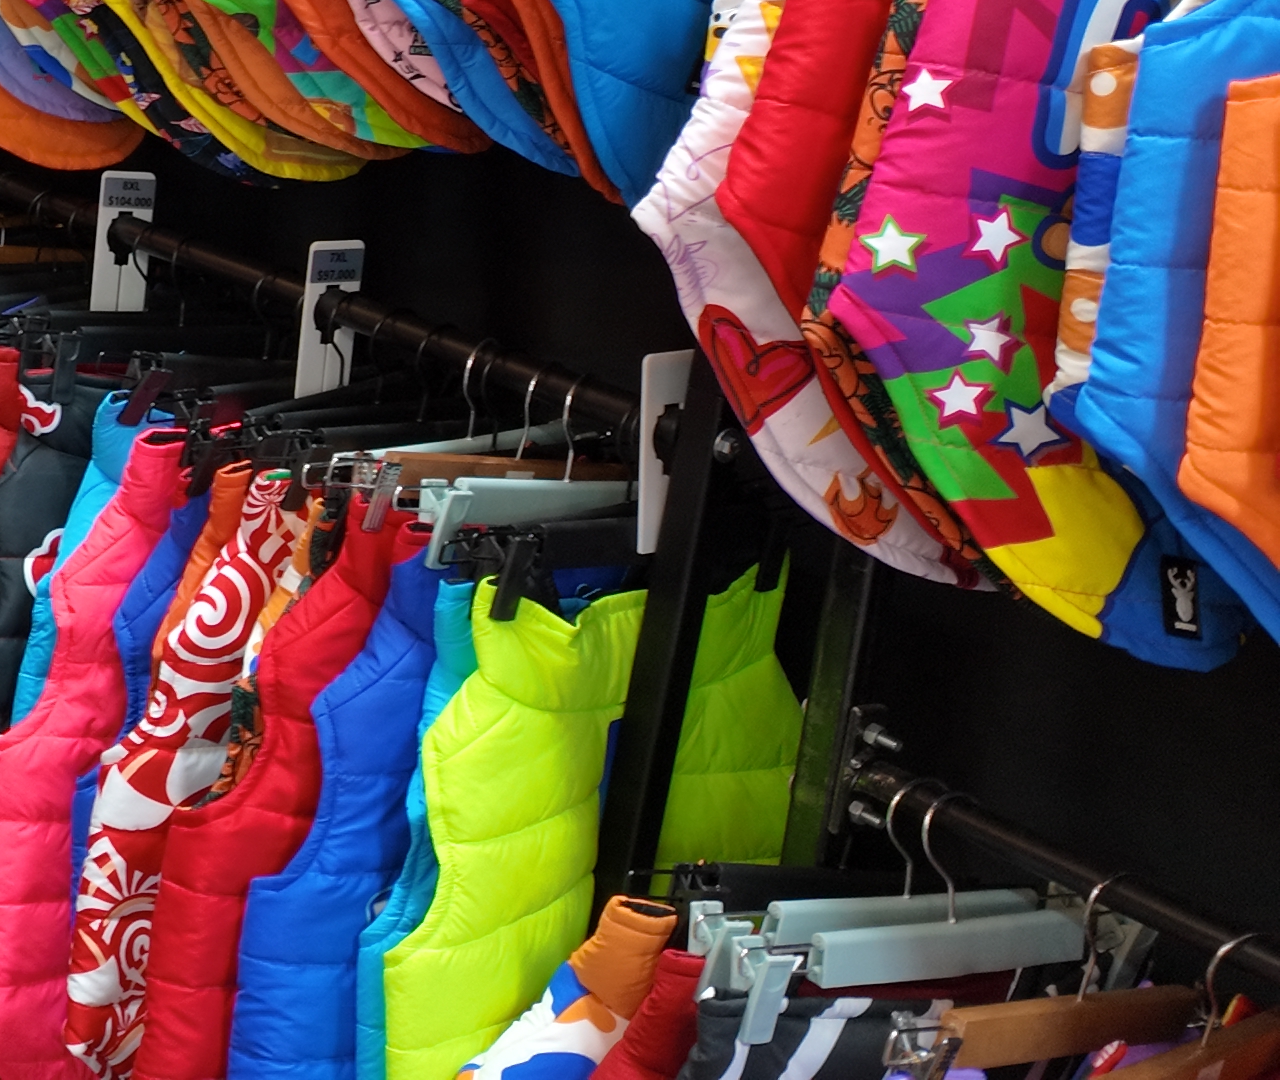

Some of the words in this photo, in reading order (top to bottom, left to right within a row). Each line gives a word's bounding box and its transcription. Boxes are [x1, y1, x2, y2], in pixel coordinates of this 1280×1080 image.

[122, 181, 141, 191] 8XL
[108, 195, 153, 207] $104.000
[330, 251, 347, 263] 7XL
[317, 268, 356, 281] $97.000
